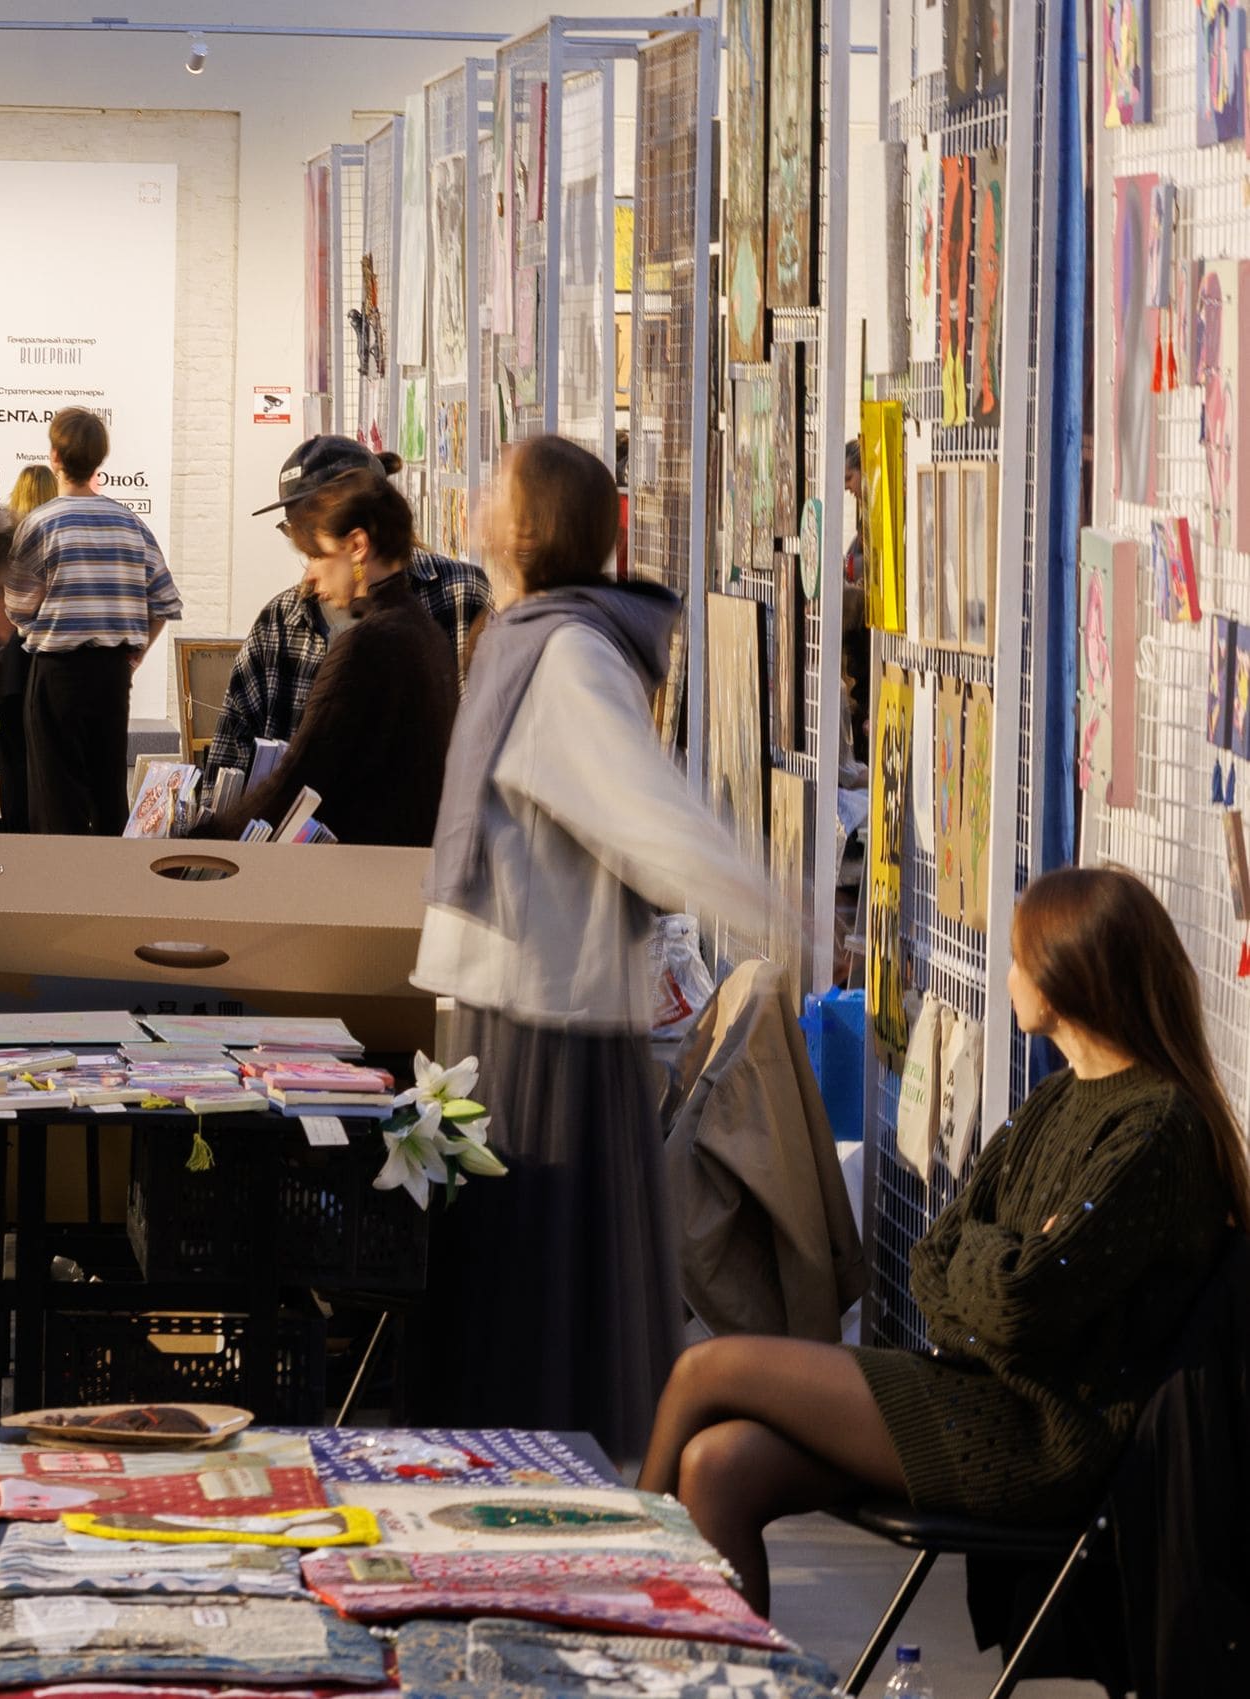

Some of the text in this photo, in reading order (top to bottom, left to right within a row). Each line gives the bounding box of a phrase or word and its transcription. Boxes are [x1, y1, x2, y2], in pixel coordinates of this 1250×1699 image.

[7, 335, 97, 346] Генеральный партнер
[64, 389, 105, 398] партнеры
